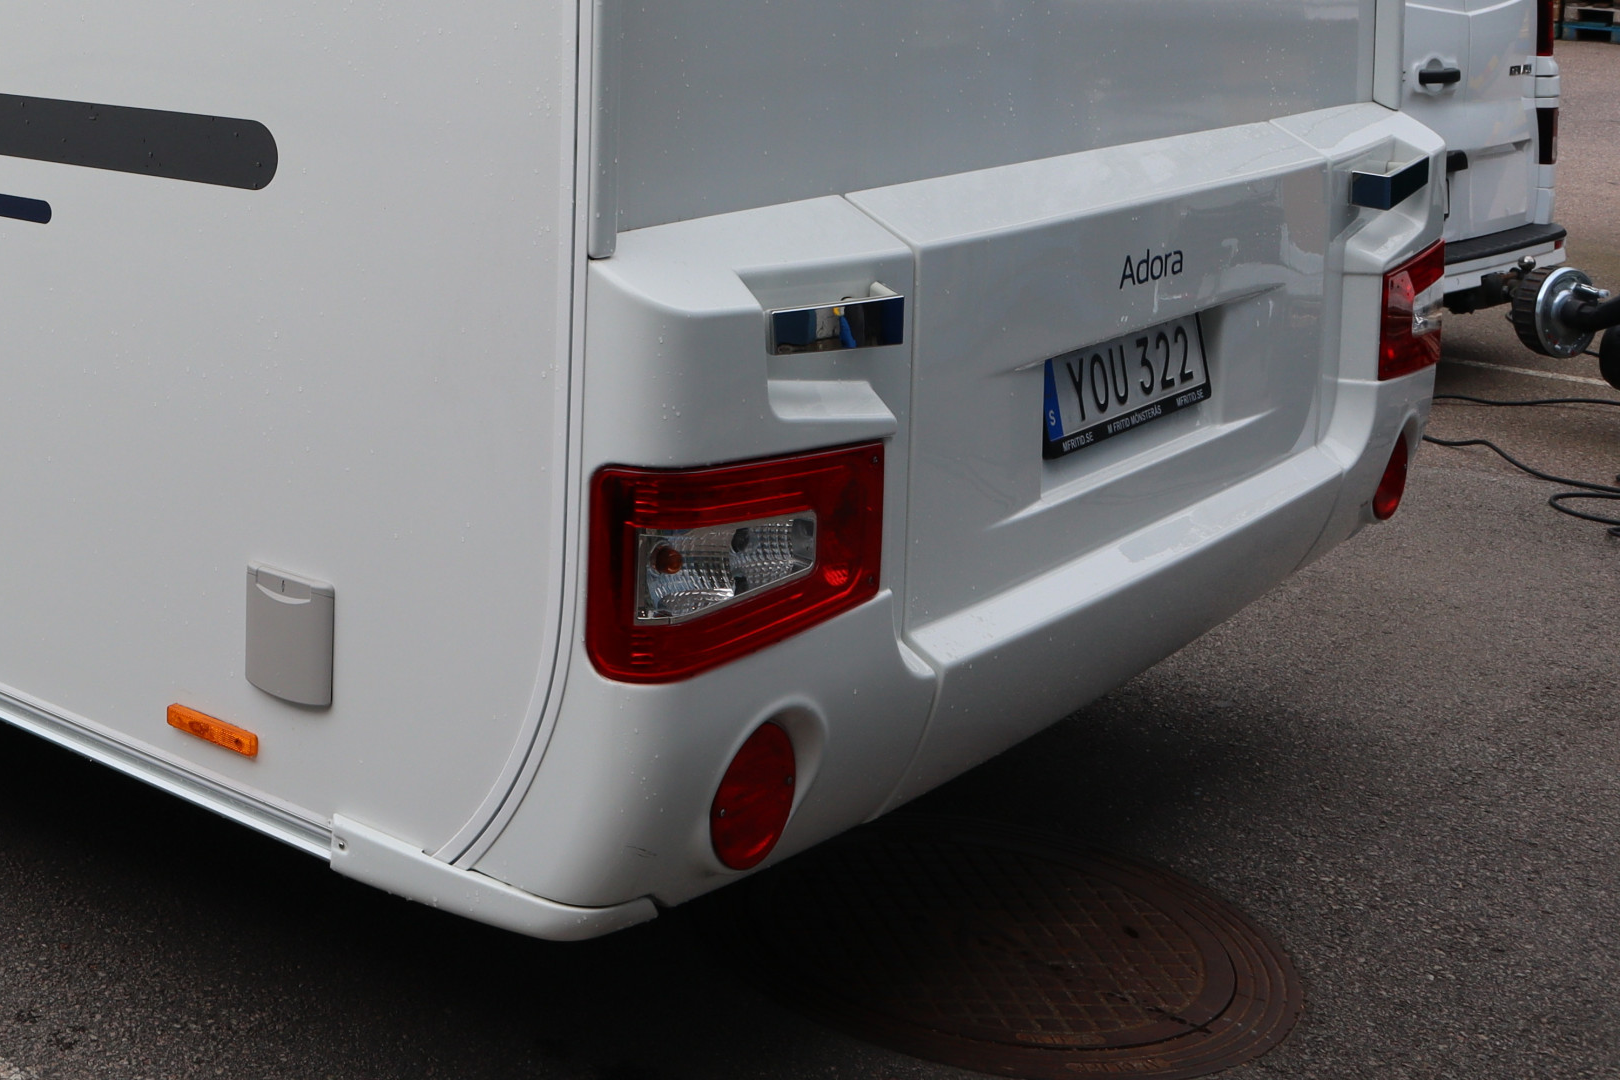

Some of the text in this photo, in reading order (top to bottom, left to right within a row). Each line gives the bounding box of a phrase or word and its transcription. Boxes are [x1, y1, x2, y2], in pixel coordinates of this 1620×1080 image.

[1119, 249, 1184, 289] Adora
[1048, 325, 1194, 426] S YOU 322
[1175, 388, 1204, 407] MFRITID.SE
[1113, 417, 1130, 434] FRITID
[1130, 404, 1162, 425] MÖNSTERÅS
[1062, 431, 1094, 452] MFRITID.SE
